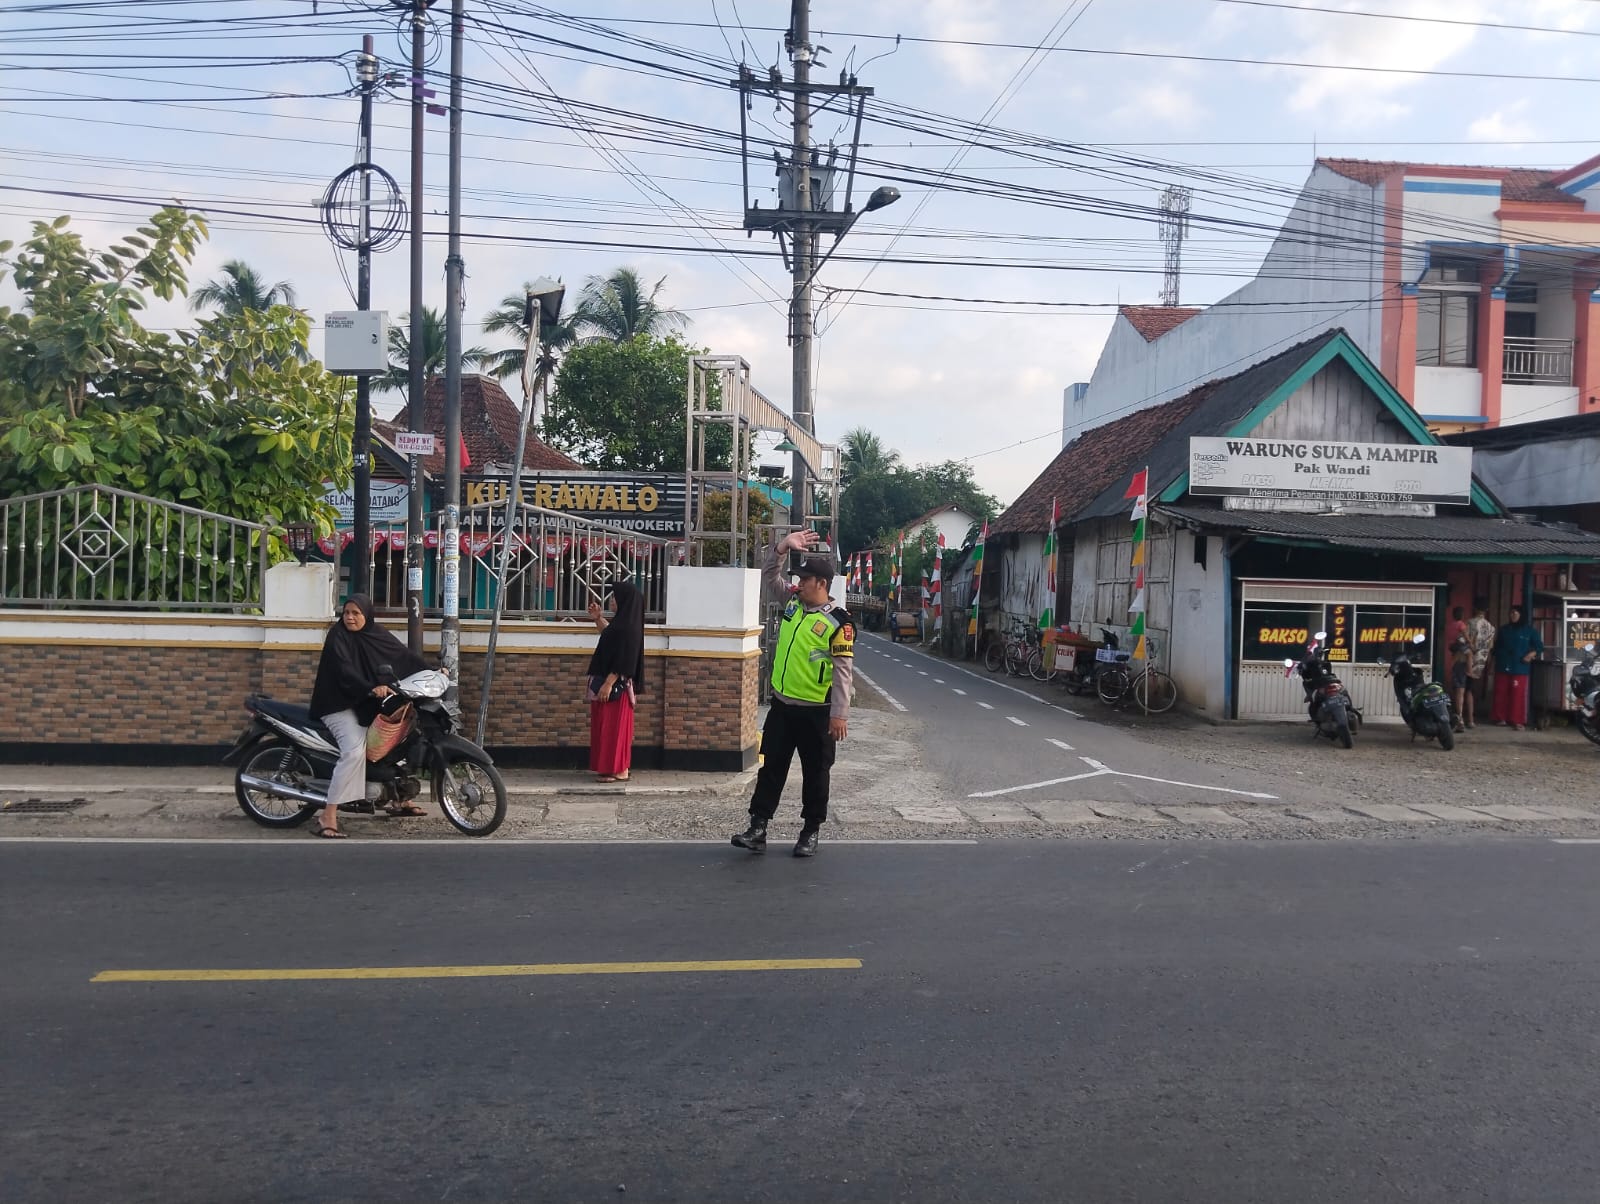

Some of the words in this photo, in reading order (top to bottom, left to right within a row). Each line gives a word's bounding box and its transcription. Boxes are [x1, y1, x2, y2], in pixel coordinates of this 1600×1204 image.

[1226, 441, 1307, 458] WARUNG
[1311, 444, 1362, 460] SUKA
[1366, 447, 1438, 464] MAMPIR
[1294, 462, 1320, 474] Pak
[1326, 464, 1371, 475] Wandi
[370, 495, 399, 506] ATANG
[535, 483, 659, 513] RAWALO
[1249, 488, 1289, 497] Menerima
[1291, 490, 1326, 499] Pesanan
[487, 516, 524, 527] RAA
[1334, 606, 1345, 646] SOTO
[1259, 628, 1308, 643] BAKSO
[1360, 628, 1388, 642] MIE
